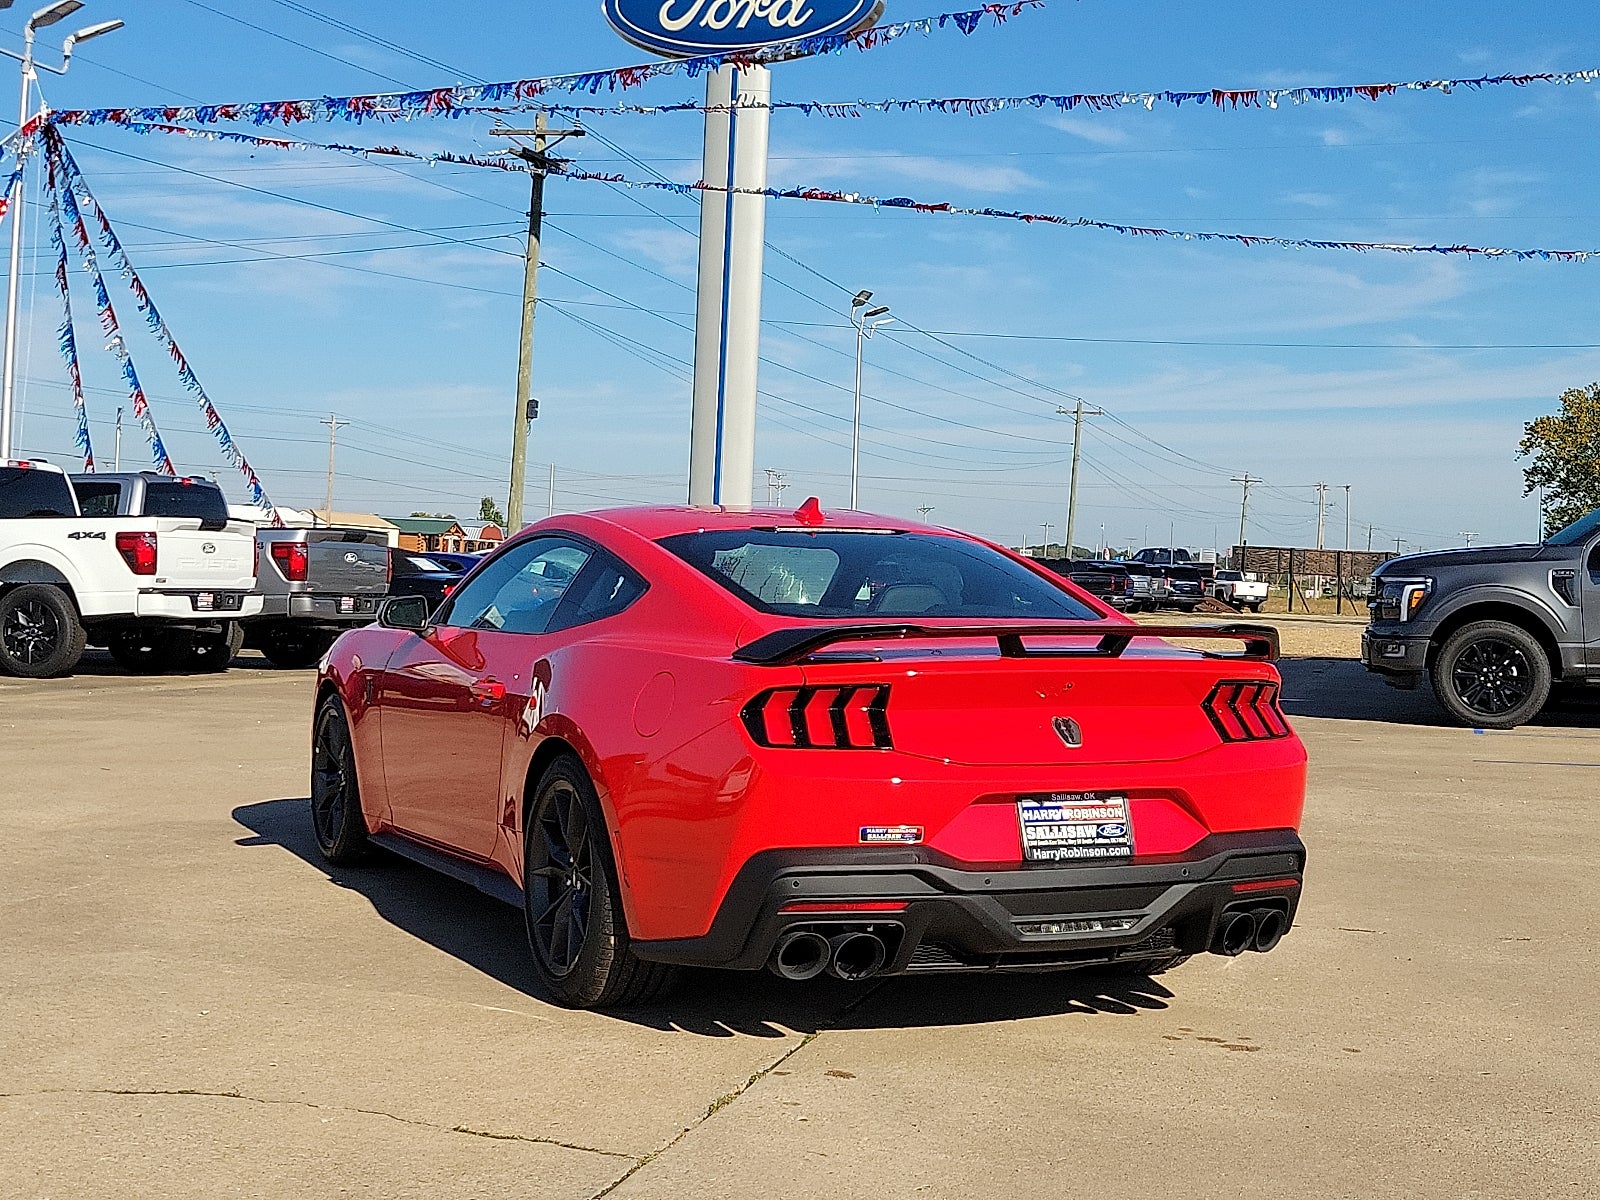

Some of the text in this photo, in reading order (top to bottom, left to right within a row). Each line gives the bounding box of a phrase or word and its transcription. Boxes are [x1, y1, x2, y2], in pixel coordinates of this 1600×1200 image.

[1051, 792, 1096, 801] Sallisaw, OK
[1023, 808, 1123, 821] HARRY ROBINSON
[1026, 825, 1098, 840] SALLISAW
[1033, 846, 1131, 860] HarryRobinson.com
